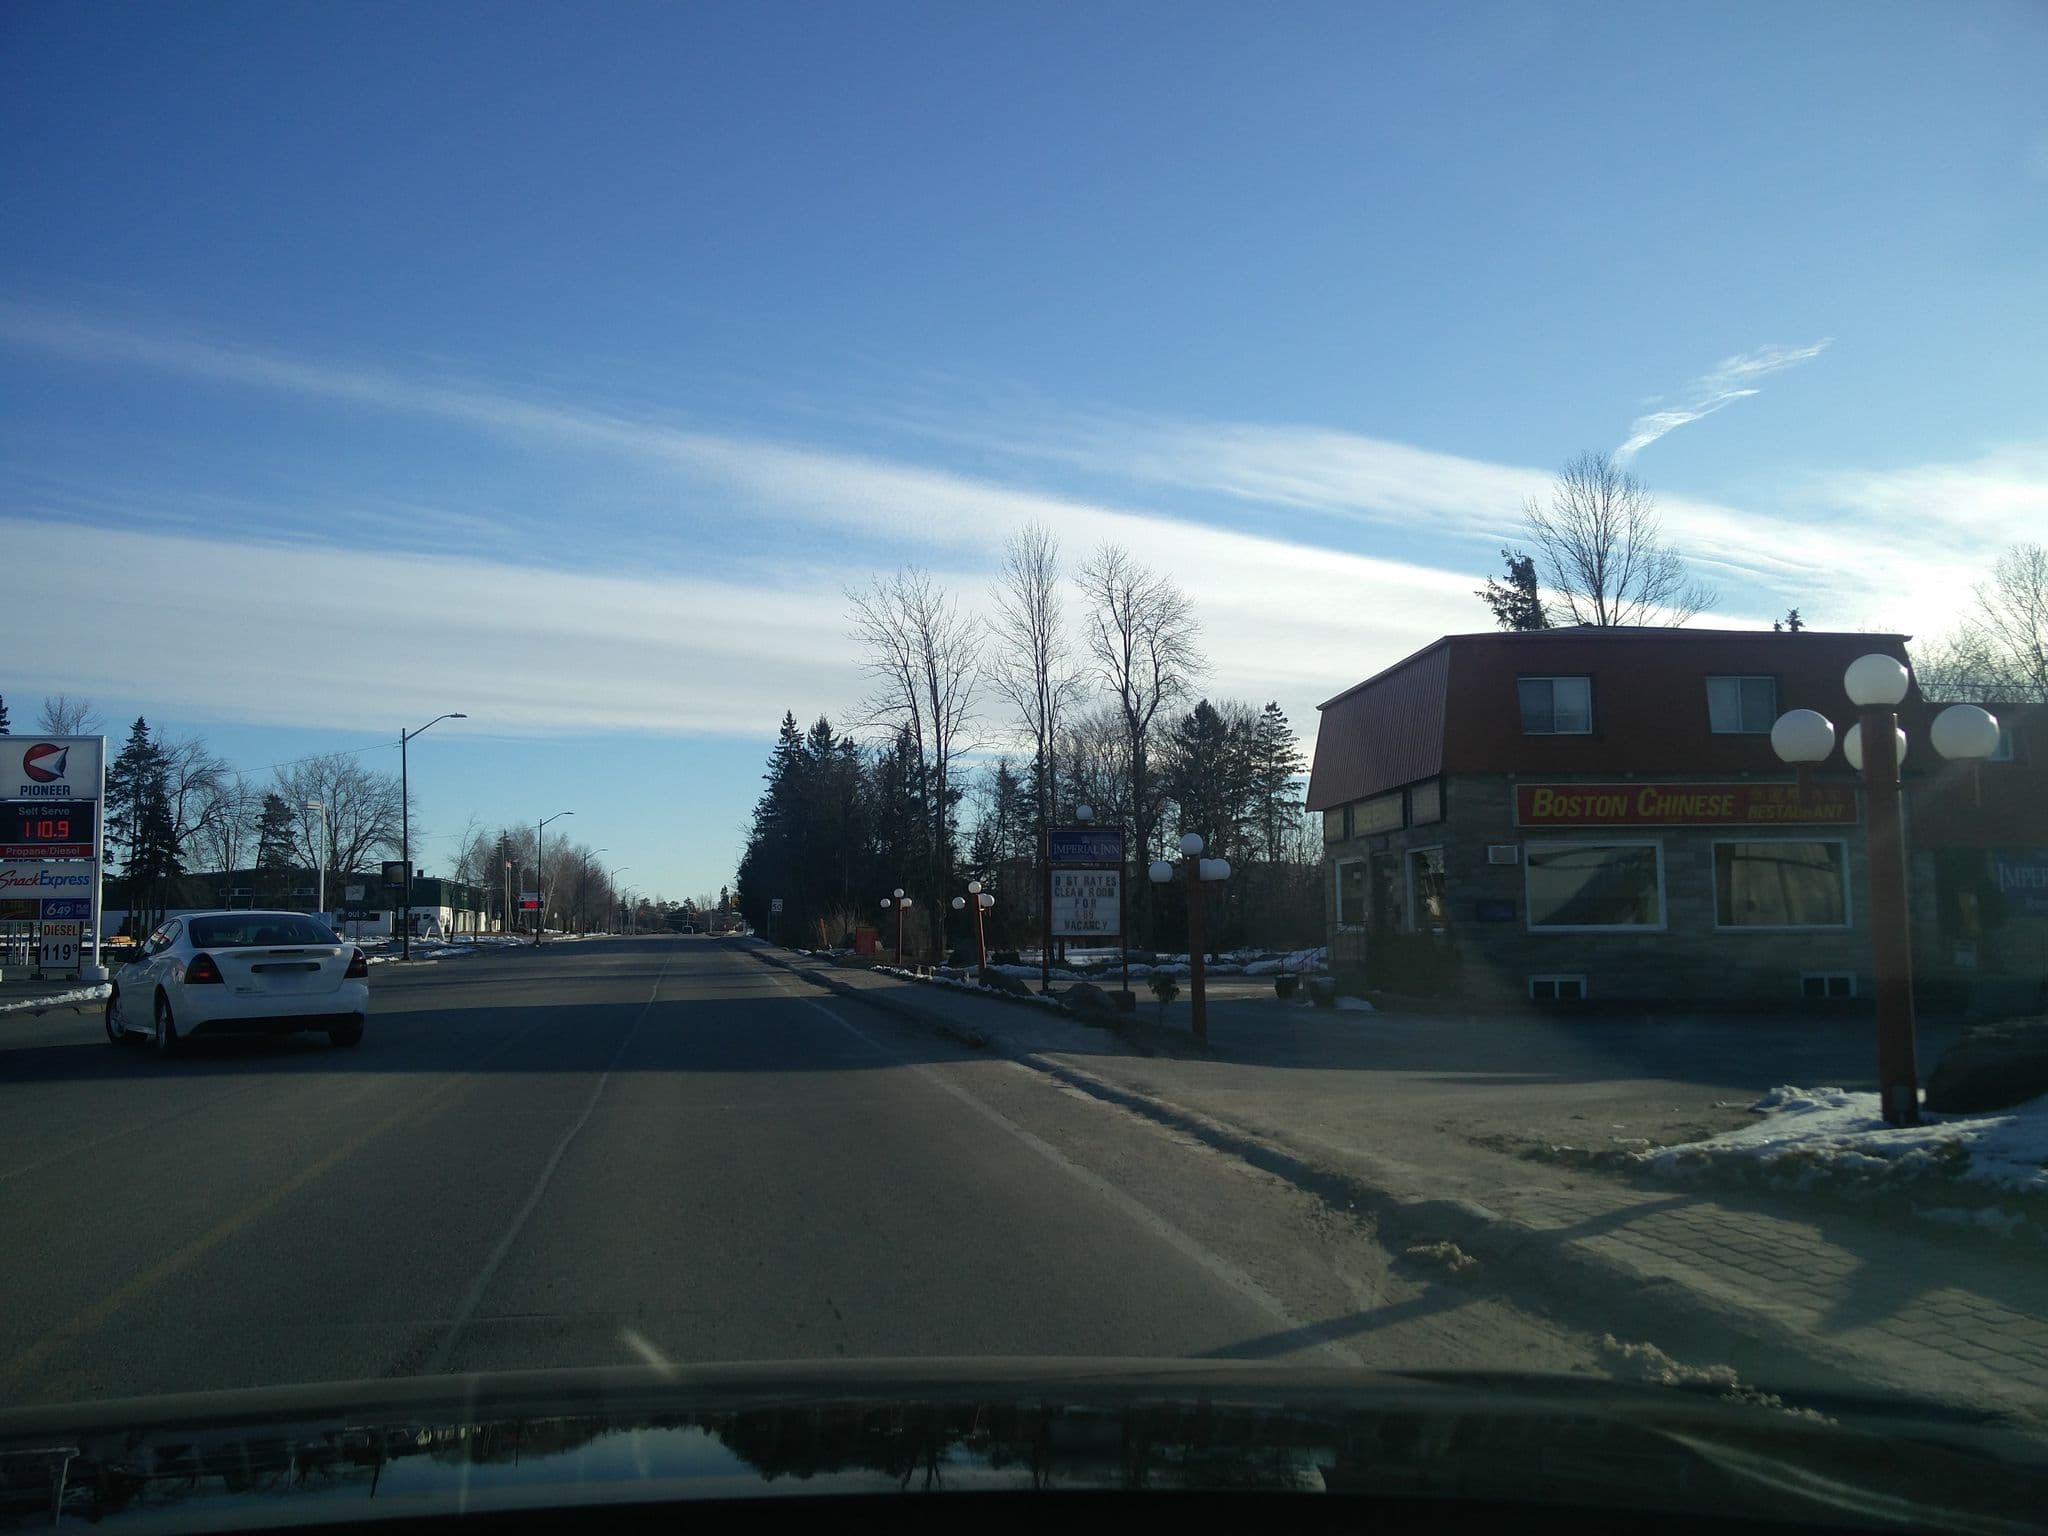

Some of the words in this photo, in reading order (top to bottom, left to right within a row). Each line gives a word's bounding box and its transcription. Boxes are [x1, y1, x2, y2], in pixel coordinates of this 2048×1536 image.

[20, 785, 71, 796] PIONEER
[1531, 788, 1628, 817] BOSTON
[1637, 787, 1737, 817] CHINESE
[18, 806, 38, 816] Self
[41, 806, 70, 816] Serve
[25, 820, 69, 838] 110.9
[6, 847, 80, 857] Propane/Diesel
[1054, 842, 1099, 855] IMPERIAL
[1101, 842, 1120, 855] INN
[1055, 876, 1078, 887] BST
[1083, 876, 1117, 887] RATES
[1054, 887, 1084, 897] CLEAN
[1075, 898, 1097, 909] FOR
[46, 903, 72, 916] 649
[1064, 920, 1107, 930] VACANCY
[44, 925, 78, 937] DIESEL
